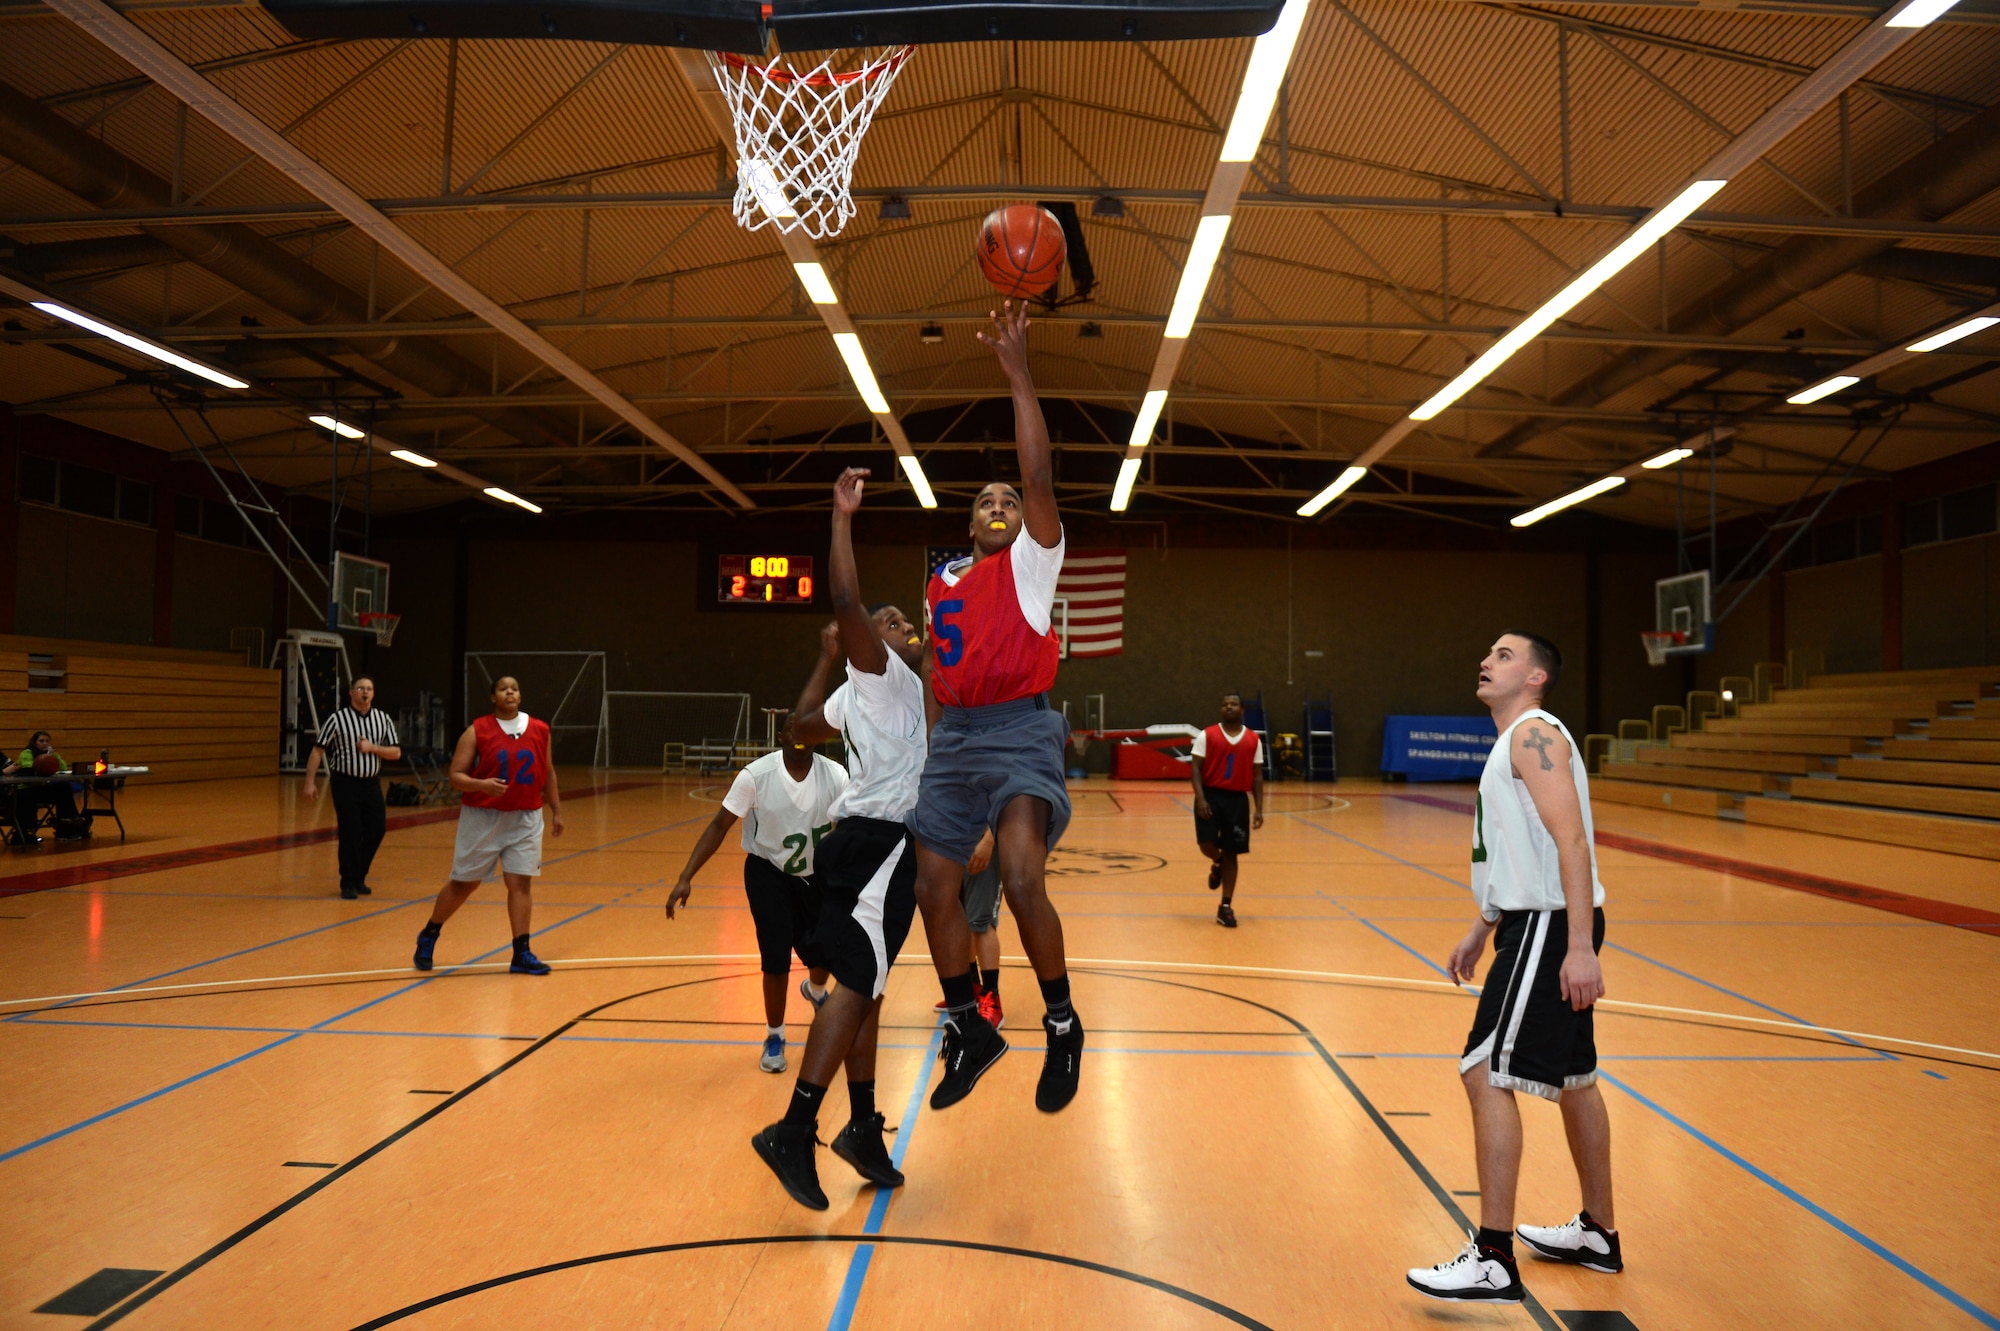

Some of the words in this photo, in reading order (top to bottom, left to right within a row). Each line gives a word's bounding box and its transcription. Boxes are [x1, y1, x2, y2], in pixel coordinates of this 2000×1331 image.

[732, 576, 746, 597] 2
[765, 583, 772, 601] 1
[798, 577, 812, 597] 0
[934, 599, 964, 667] 5
[1409, 731, 1447, 741] SKELTON
[1447, 732, 1479, 743] FITNESS
[497, 749, 534, 784] 12
